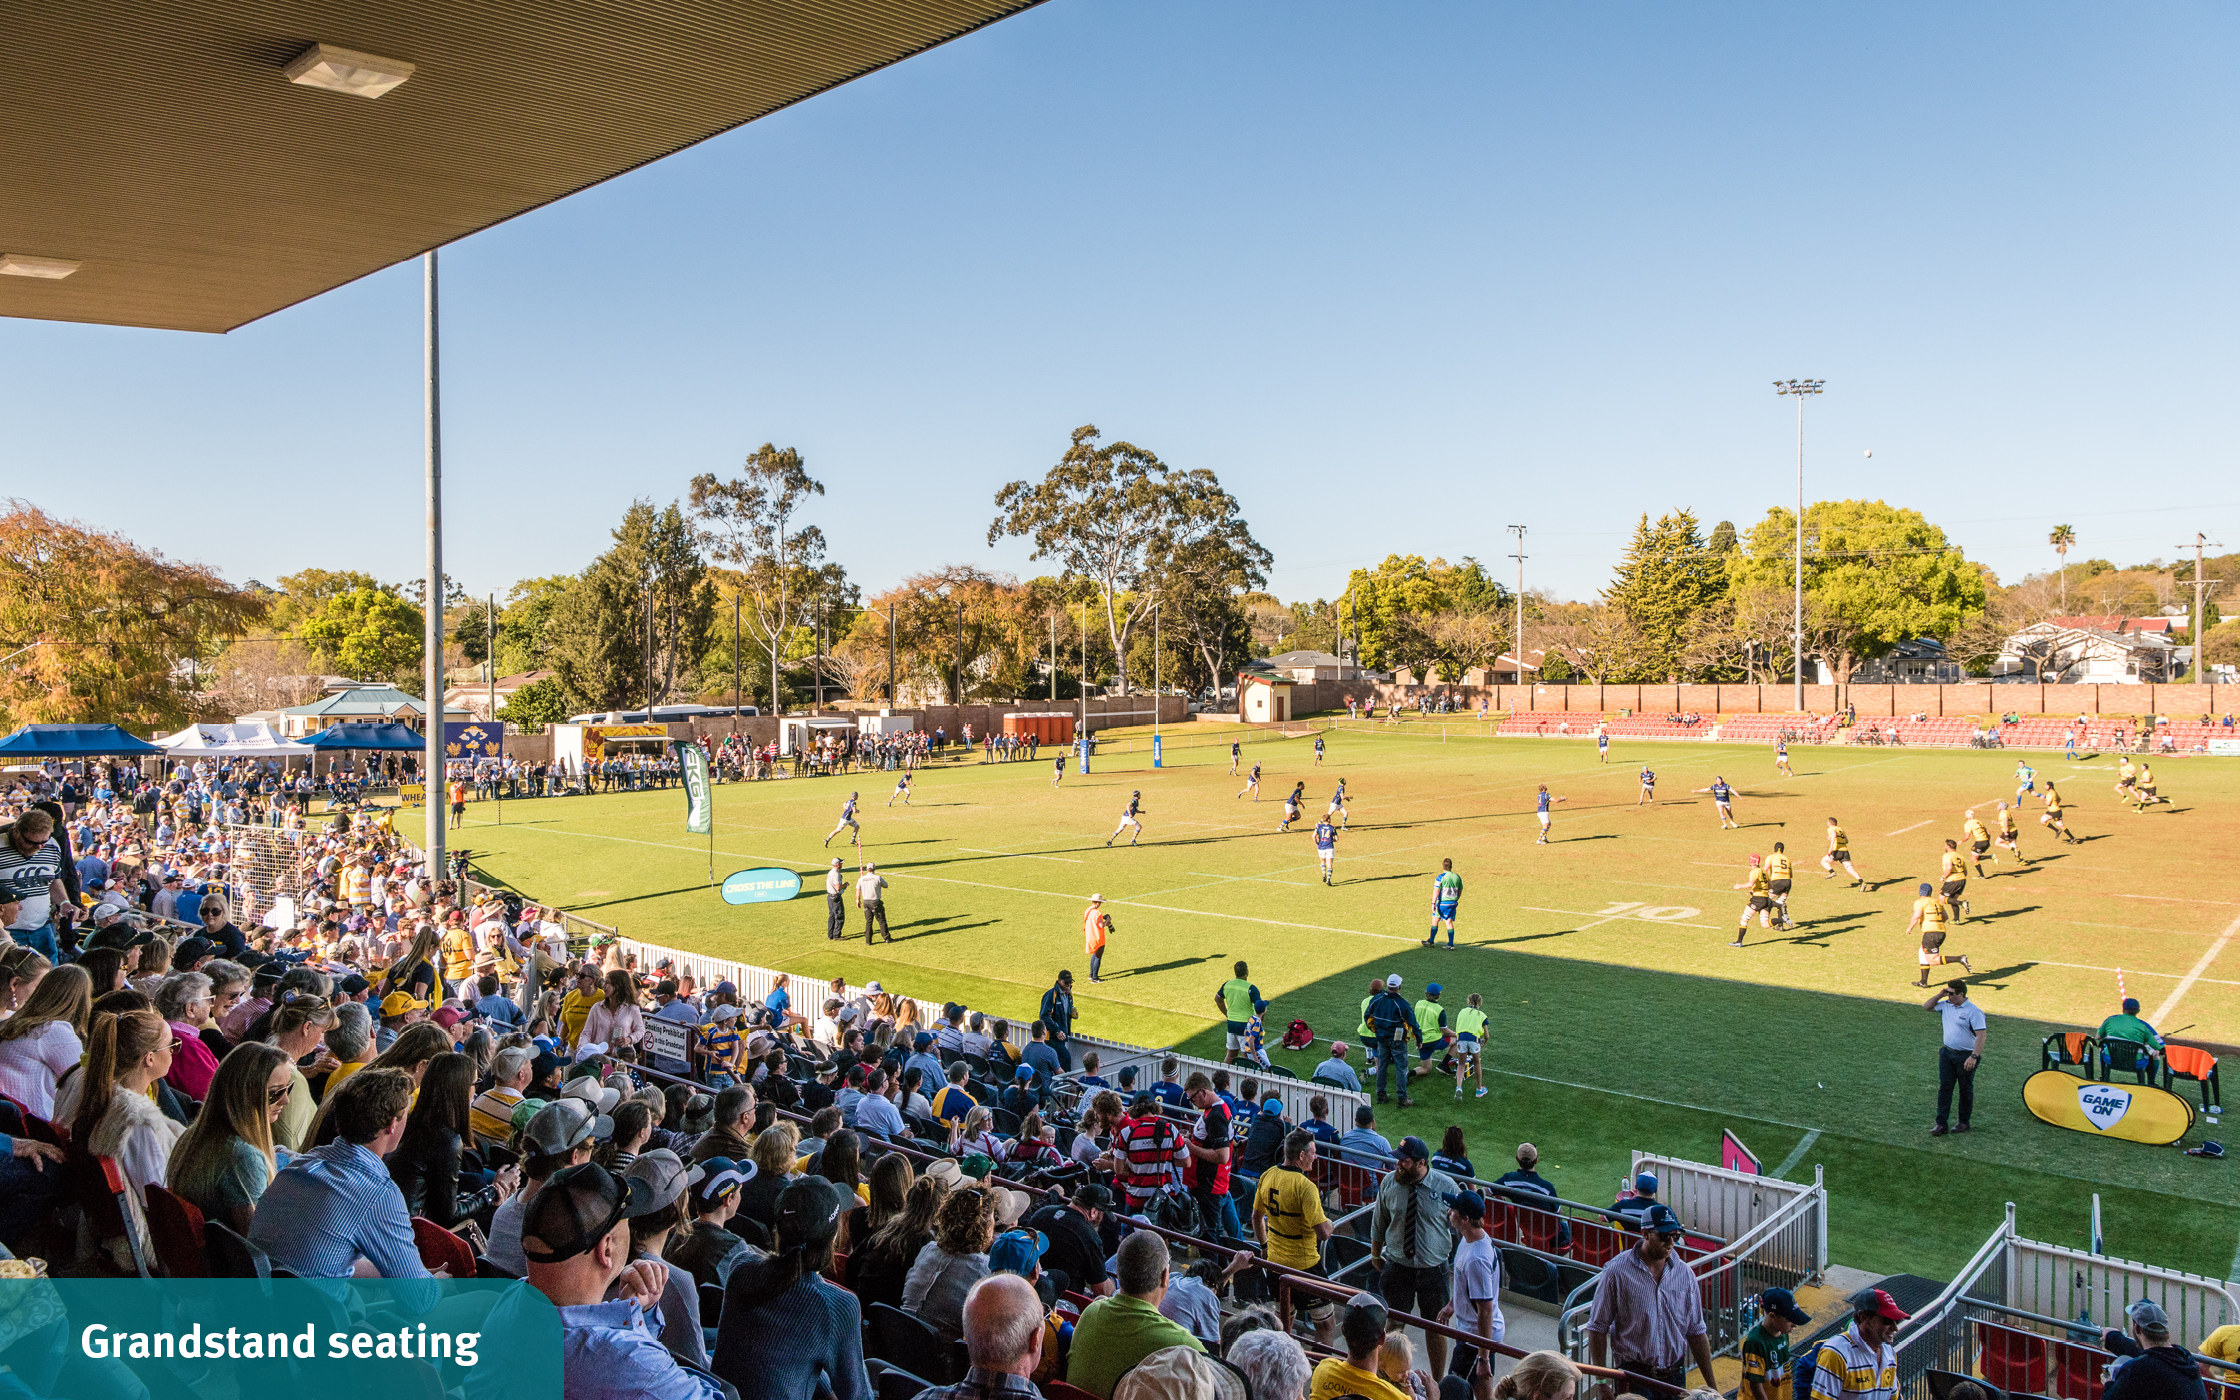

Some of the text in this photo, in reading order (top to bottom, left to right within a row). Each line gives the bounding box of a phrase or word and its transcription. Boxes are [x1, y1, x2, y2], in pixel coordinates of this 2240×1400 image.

[1321, 829, 1330, 838] 14
[1780, 859, 1788, 869] 5
[724, 879, 797, 893] CROSS THE LINE
[1595, 901, 1702, 920] 10
[645, 1021, 685, 1039] Smoking Prohibited
[665, 1038, 685, 1050] Grandstand
[2082, 1094, 2125, 1109] GAME
[2092, 1104, 2114, 1116] ON
[1268, 1187, 1280, 1217] 5
[1856, 1376, 1871, 1384] BLK
